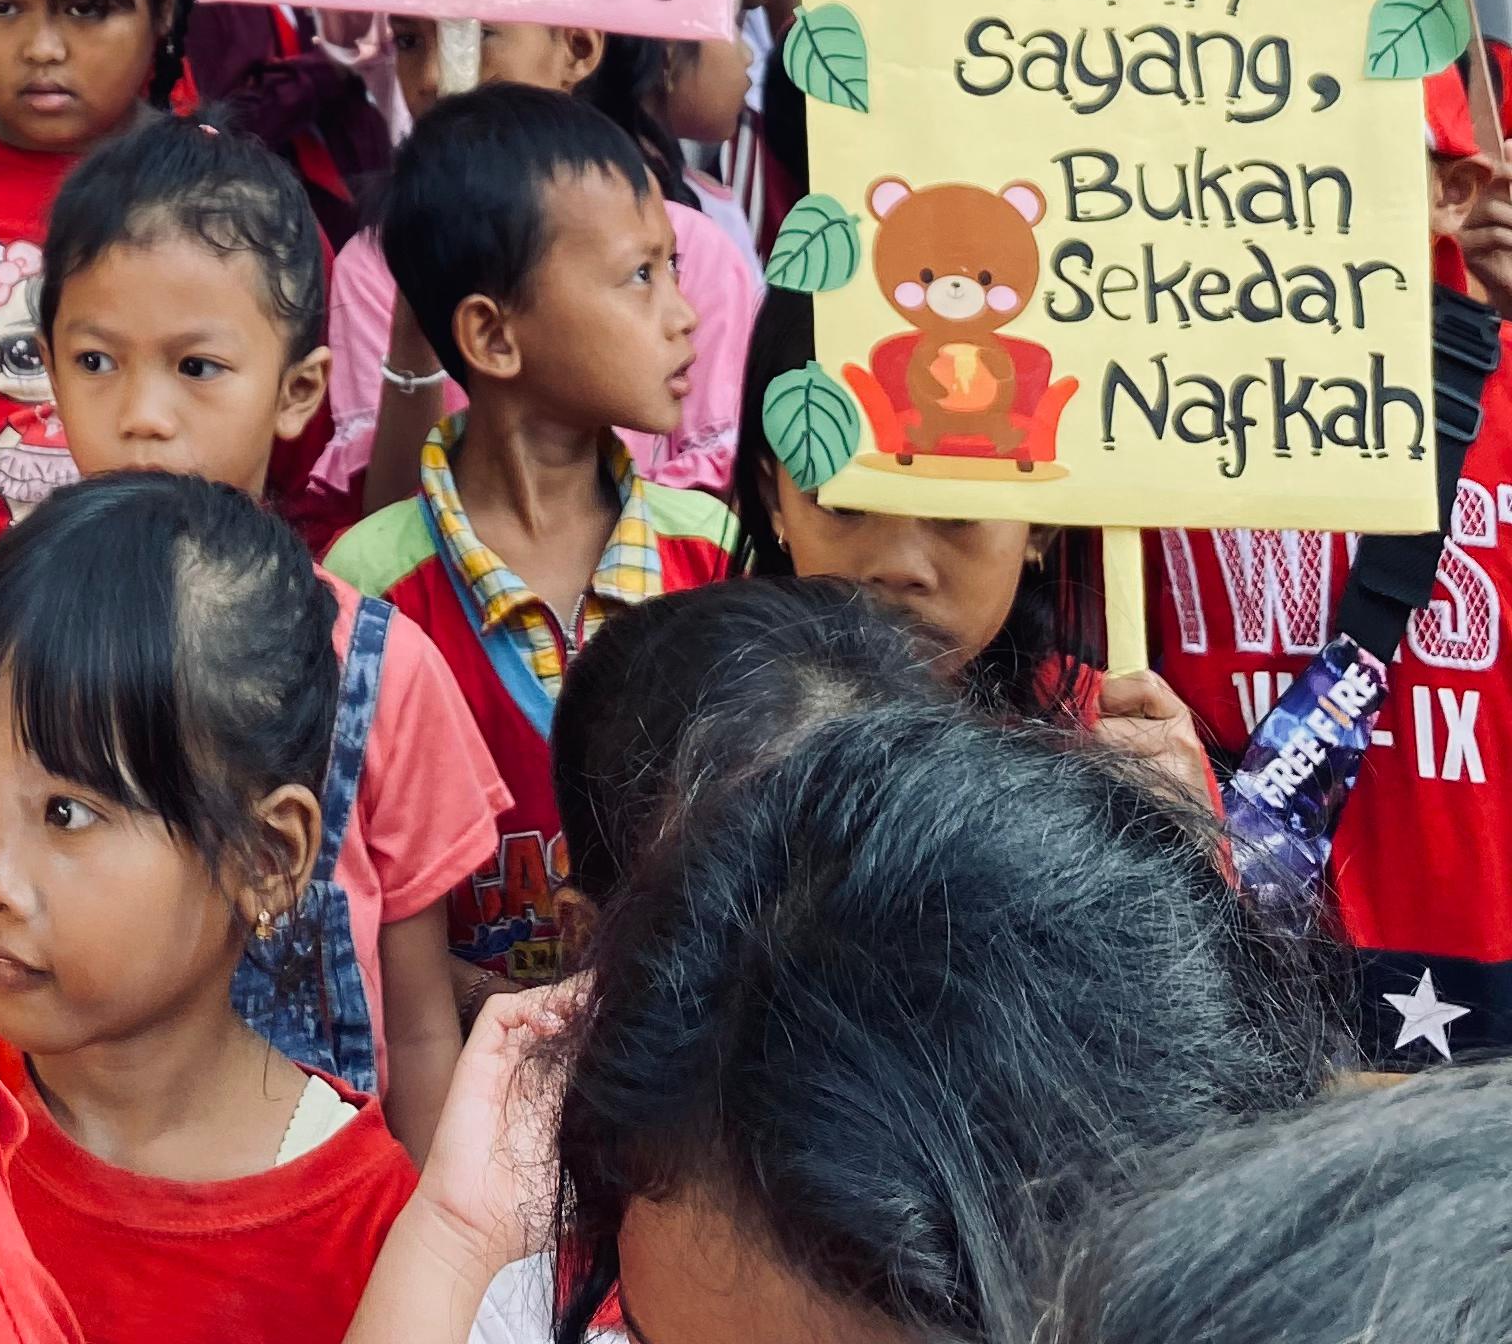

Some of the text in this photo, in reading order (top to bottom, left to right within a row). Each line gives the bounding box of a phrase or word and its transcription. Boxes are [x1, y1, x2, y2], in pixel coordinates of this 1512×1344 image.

[955, 17, 1342, 125] Sayang,
[1051, 147, 1353, 234] Bukan
[1044, 239, 1408, 332] Sekedar
[1101, 352, 1428, 479] Nafkah
[1413, 685, 1486, 783] IX
